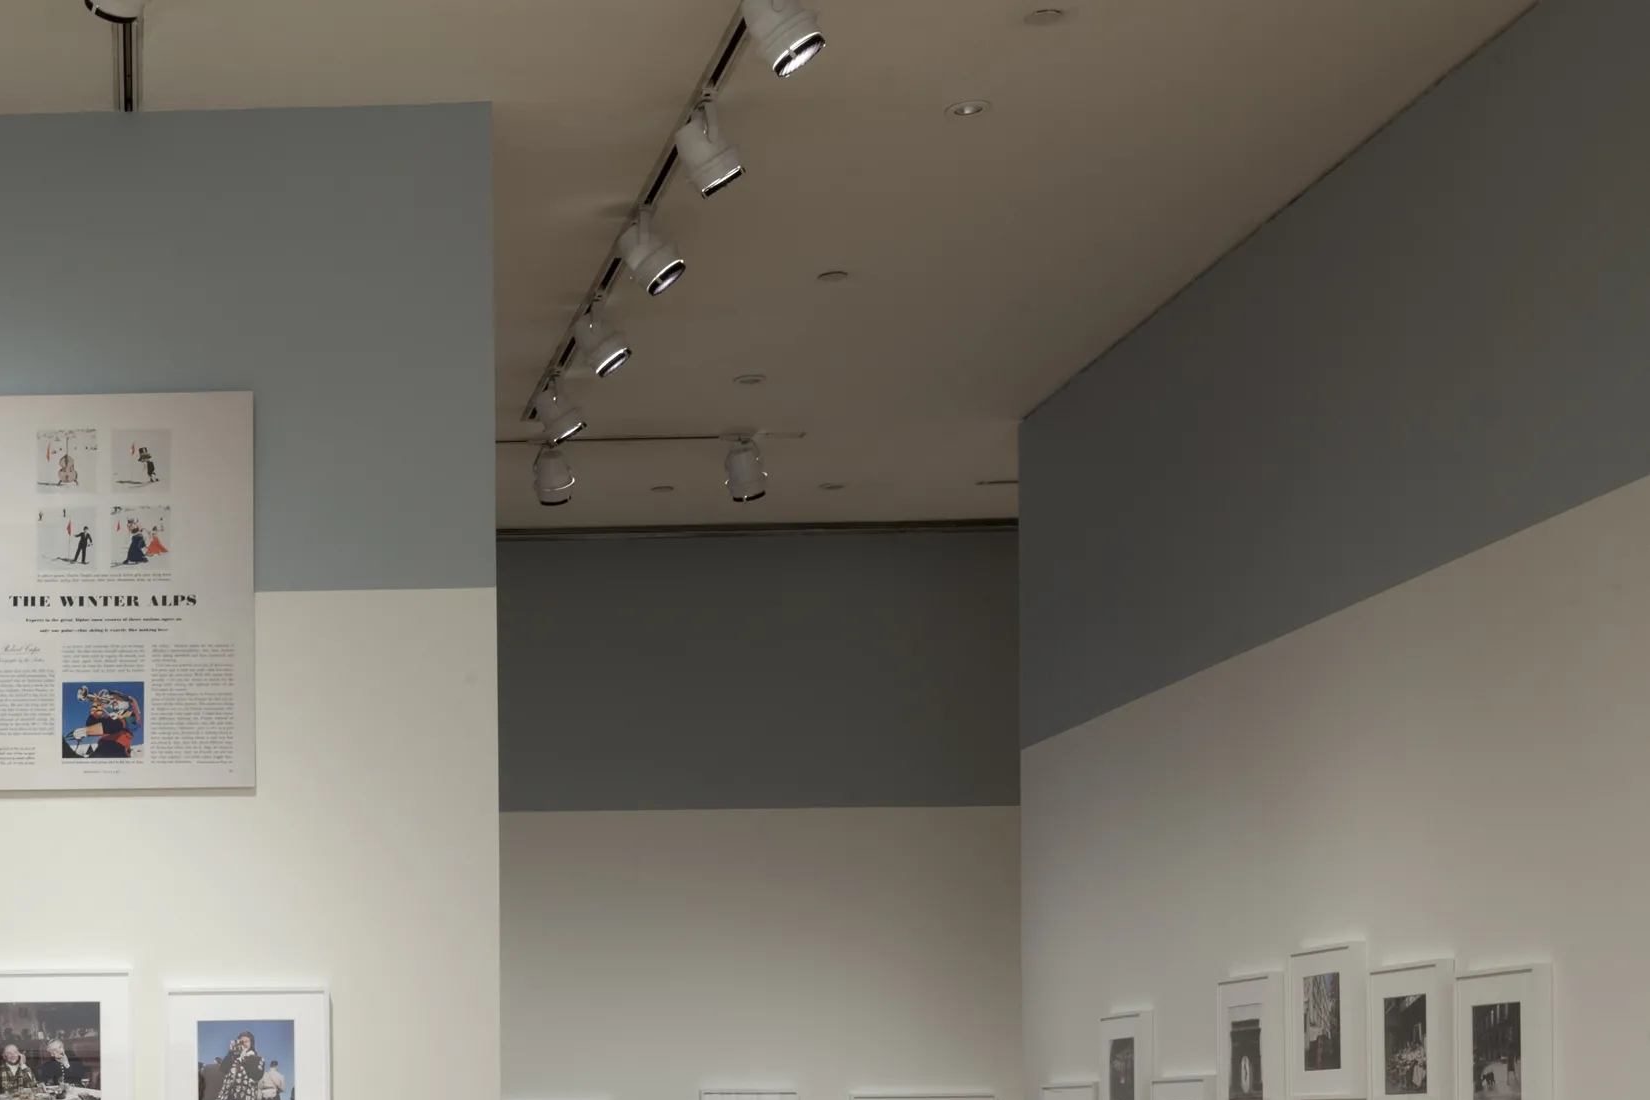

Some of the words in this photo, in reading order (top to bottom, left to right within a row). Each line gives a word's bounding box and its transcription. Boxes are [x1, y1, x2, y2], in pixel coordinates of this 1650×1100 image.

[8, 595, 51, 607] THE
[59, 595, 140, 607] WINTER
[149, 594, 198, 606] ALPS
